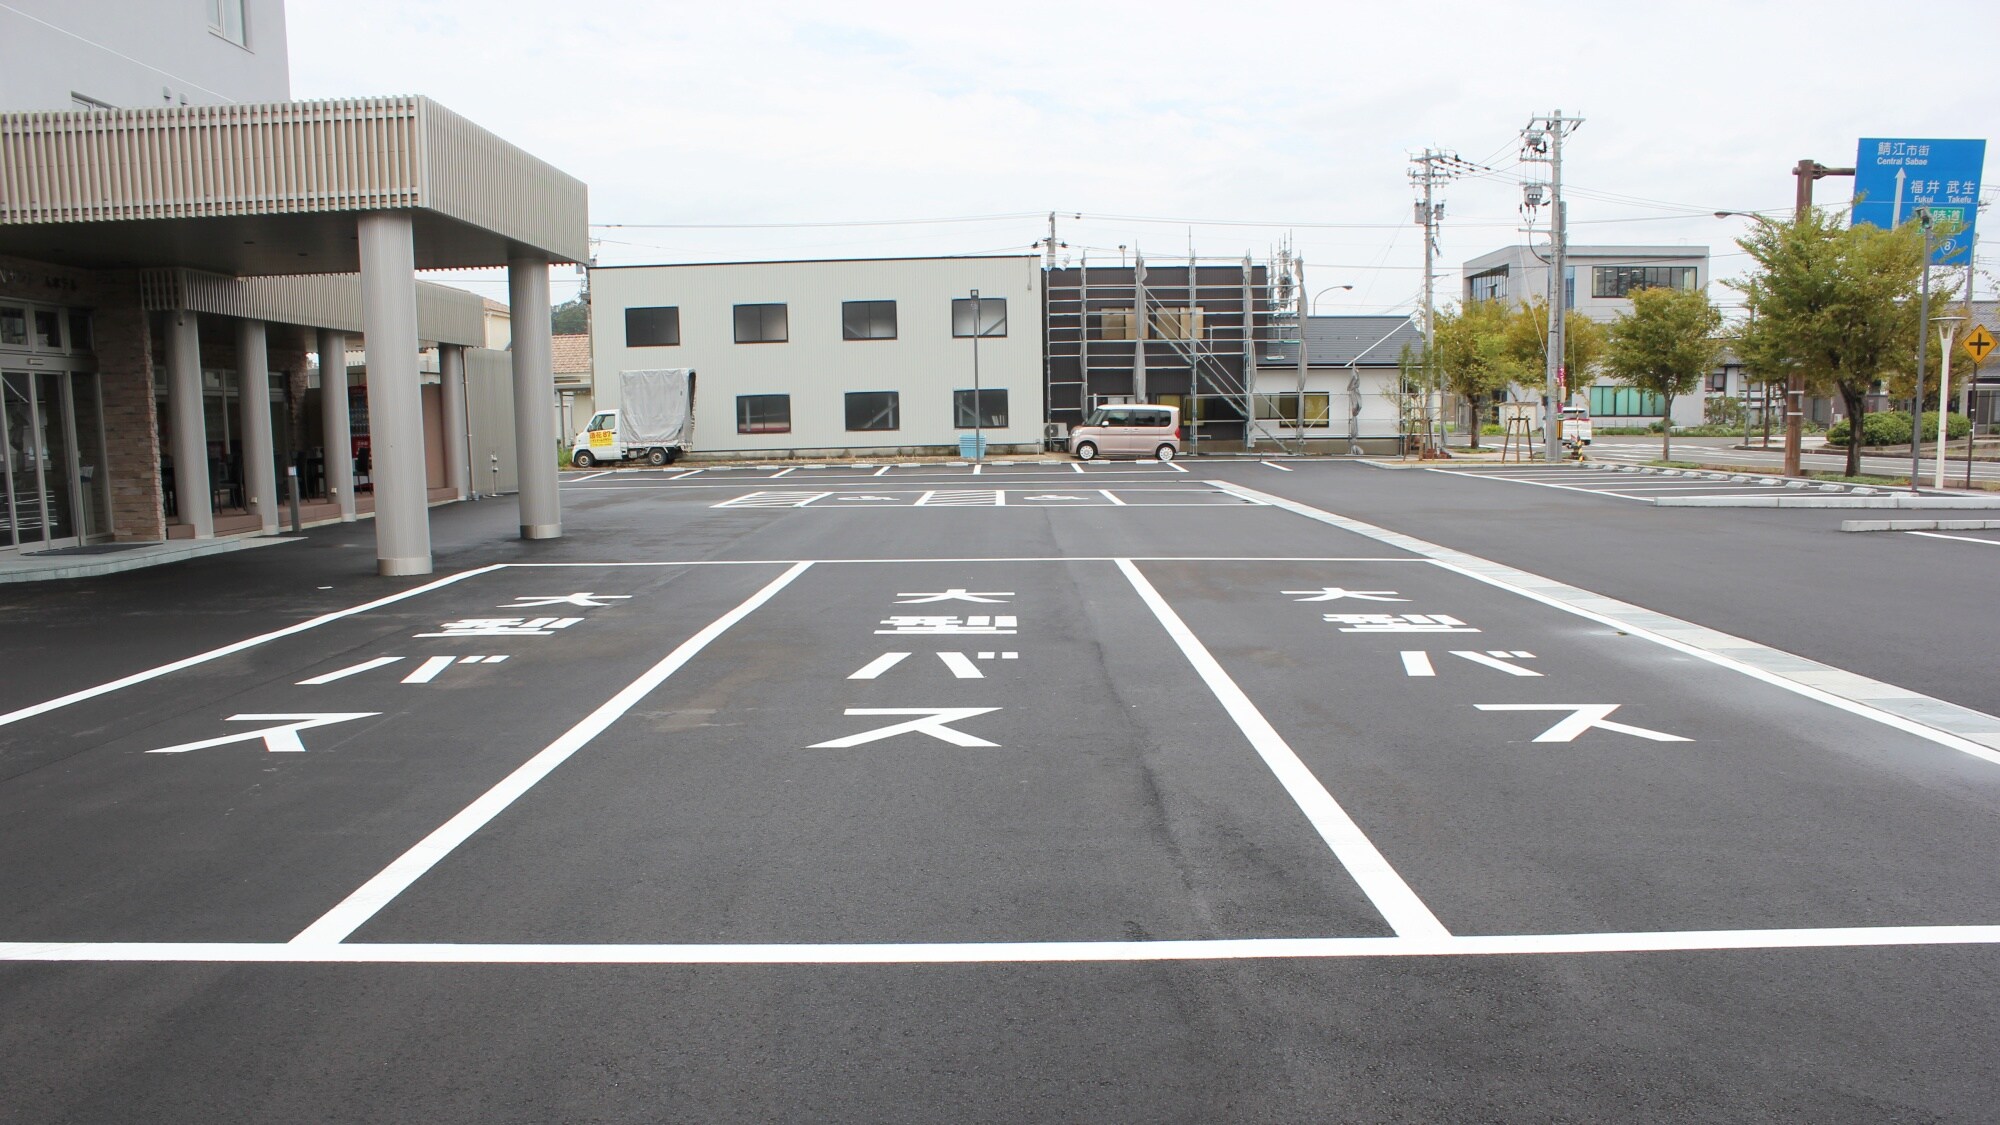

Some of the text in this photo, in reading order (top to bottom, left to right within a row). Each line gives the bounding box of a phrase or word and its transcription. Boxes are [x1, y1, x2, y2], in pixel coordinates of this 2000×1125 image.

[1877, 141, 1930, 156] 鯖江市街
[1877, 157, 1928, 166] Central Sabae
[1911, 180, 1976, 195] 福井 武生
[1914, 195, 1972, 204] Fukui Takefu
[1943, 240, 1951, 251] 8
[144, 591, 633, 753] 大型バス
[804, 588, 1019, 748] 大型バス
[1280, 587, 1696, 743] 大型バス
